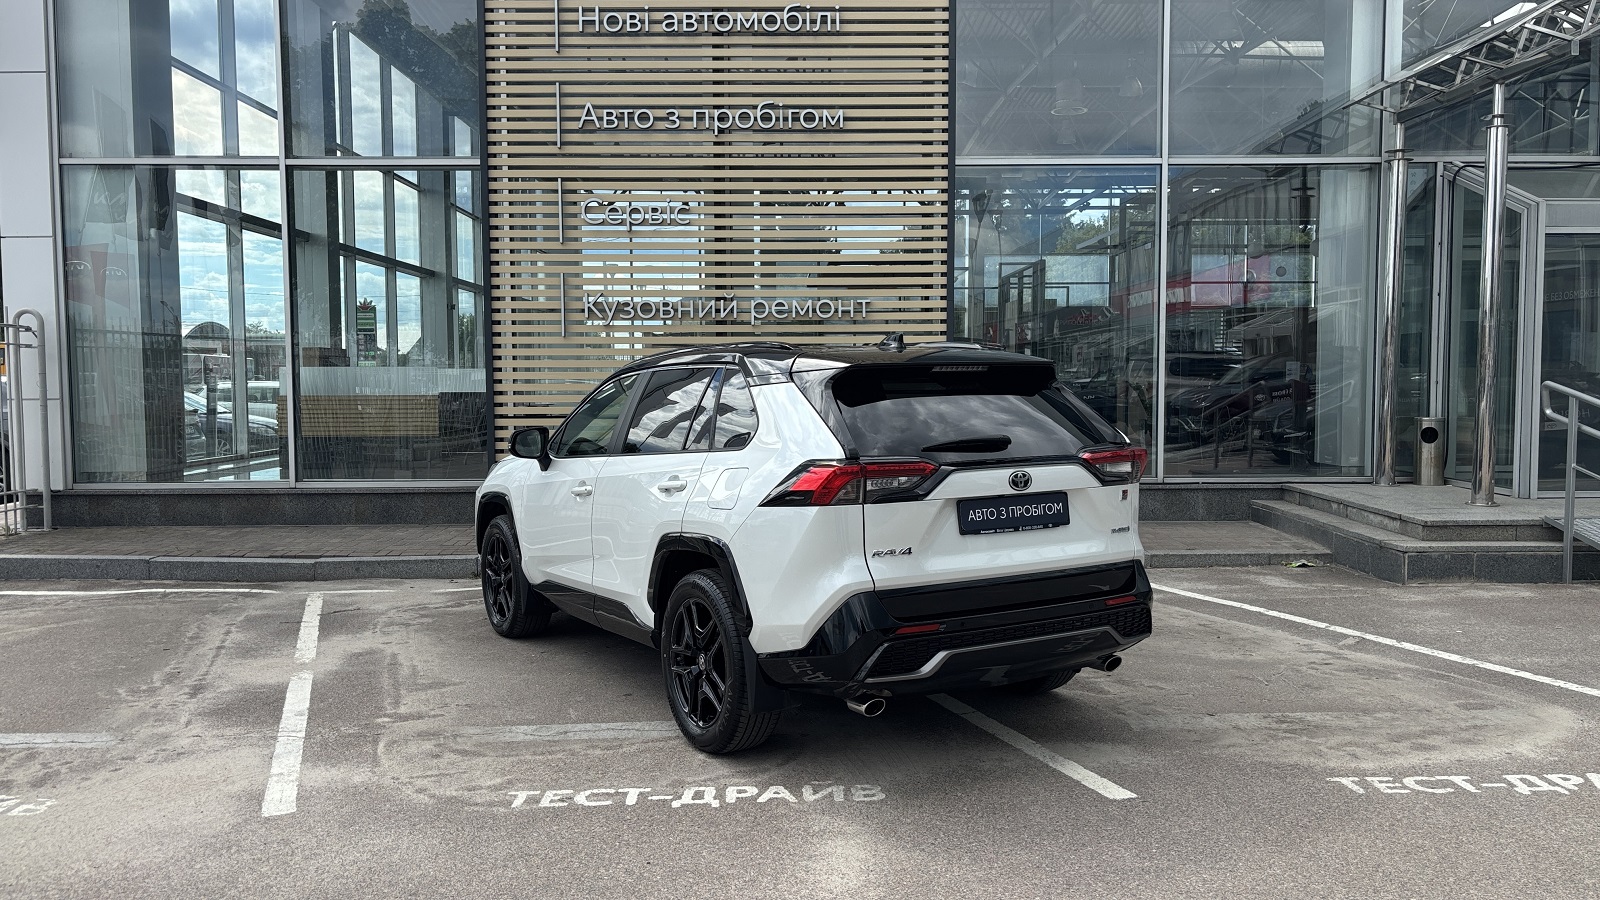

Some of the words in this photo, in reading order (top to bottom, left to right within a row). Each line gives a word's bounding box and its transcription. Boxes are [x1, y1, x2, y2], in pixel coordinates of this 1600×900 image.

[577, 5, 650, 33] Нові
[661, 3, 841, 33] автомобілі
[577, 102, 655, 130] Авто
[664, 108, 681, 130] з
[692, 100, 845, 136] пробігом
[580, 198, 691, 232] Сервіс
[583, 292, 739, 326] Кузовний
[750, 297, 871, 326] ремонт
[968, 507, 997, 522] АВТО
[999, 507, 1007, 519] З
[1009, 502, 1064, 518] ПРОБІГОМ
[871, 546, 913, 558] RAV4
[507, 780, 887, 810] ТЕСТ-ДРАЙВ
